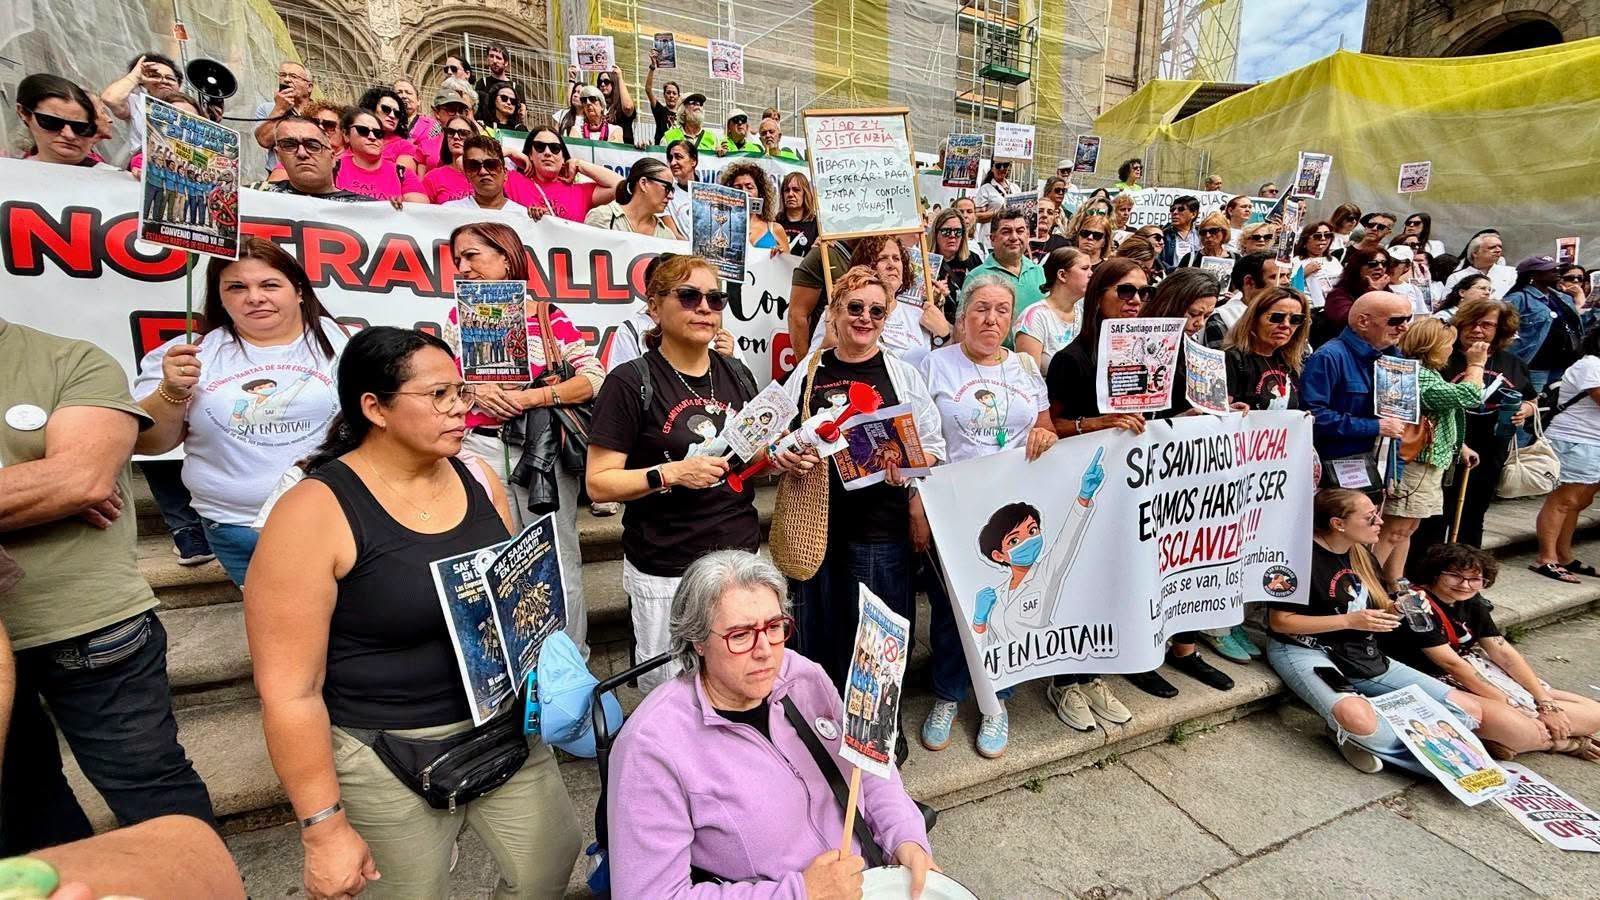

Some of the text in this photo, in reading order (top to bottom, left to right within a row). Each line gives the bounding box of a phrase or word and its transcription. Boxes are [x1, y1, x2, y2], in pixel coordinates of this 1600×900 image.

[151, 103, 238, 147] SAF SANTIAGO
[166, 124, 184, 139] EN
[861, 160, 879, 172] YA
[884, 157, 894, 166] DE
[353, 181, 376, 190] SAF
[825, 188, 856, 199] EXTRA
[861, 187, 868, 203] Y
[831, 203, 851, 212] NES
[1129, 212, 1145, 225] DE
[1, 200, 199, 282] NO
[160, 226, 191, 240] CONVENIO
[192, 232, 209, 243] DIGNO
[210, 236, 218, 245] YA
[1111, 324, 1126, 333] SAF
[1126, 323, 1152, 334] Santiago
[235, 366, 264, 380] HARTAS
[238, 424, 258, 436] SAF
[259, 422, 272, 435] EN
[971, 427, 983, 437] SAF
[1126, 443, 1160, 489] SAF
[1159, 433, 1233, 480] SANTIAGO
[1256, 470, 1288, 502] SER
[494, 526, 543, 576] SAF SANTIAGO
[453, 561, 471, 574] SAF
[500, 563, 511, 579] EN
[462, 571, 476, 581] EN
[1180, 578, 1191, 591] se
[1196, 573, 1221, 591] van,
[1225, 566, 1239, 586] los
[455, 585, 464, 593] Las
[1023, 599, 1038, 612] SAF
[1008, 632, 1030, 668] EN
[1034, 623, 1113, 661] LOITA!!!
[488, 677, 494, 686] Ni
[1503, 796, 1584, 812] HUELGA
